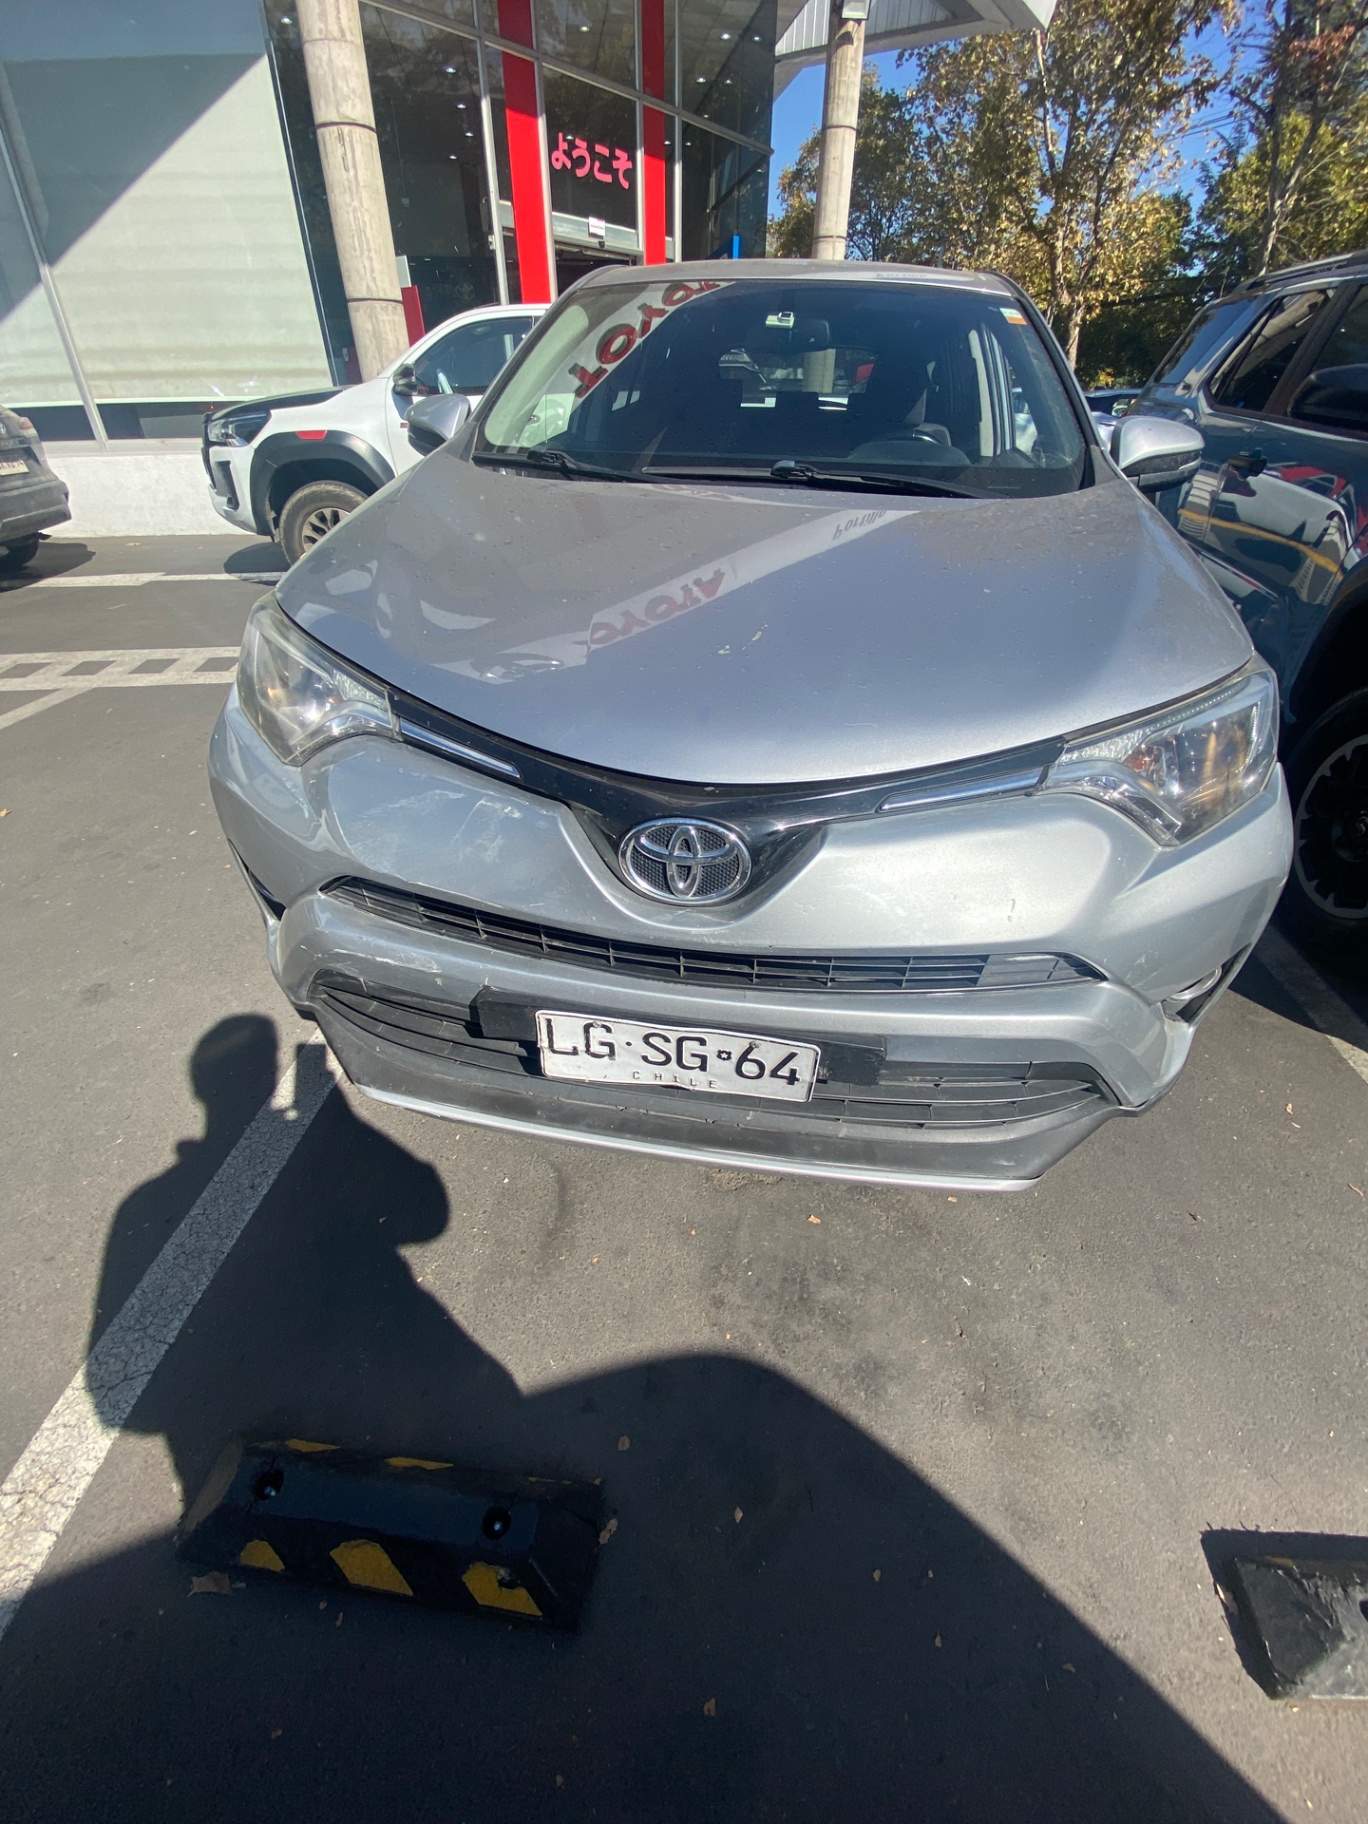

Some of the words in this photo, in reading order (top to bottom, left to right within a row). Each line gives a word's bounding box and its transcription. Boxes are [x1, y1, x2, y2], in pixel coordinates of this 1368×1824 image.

[551, 132, 633, 190] ようこそ
[632, 1070, 718, 1089] CHILE
